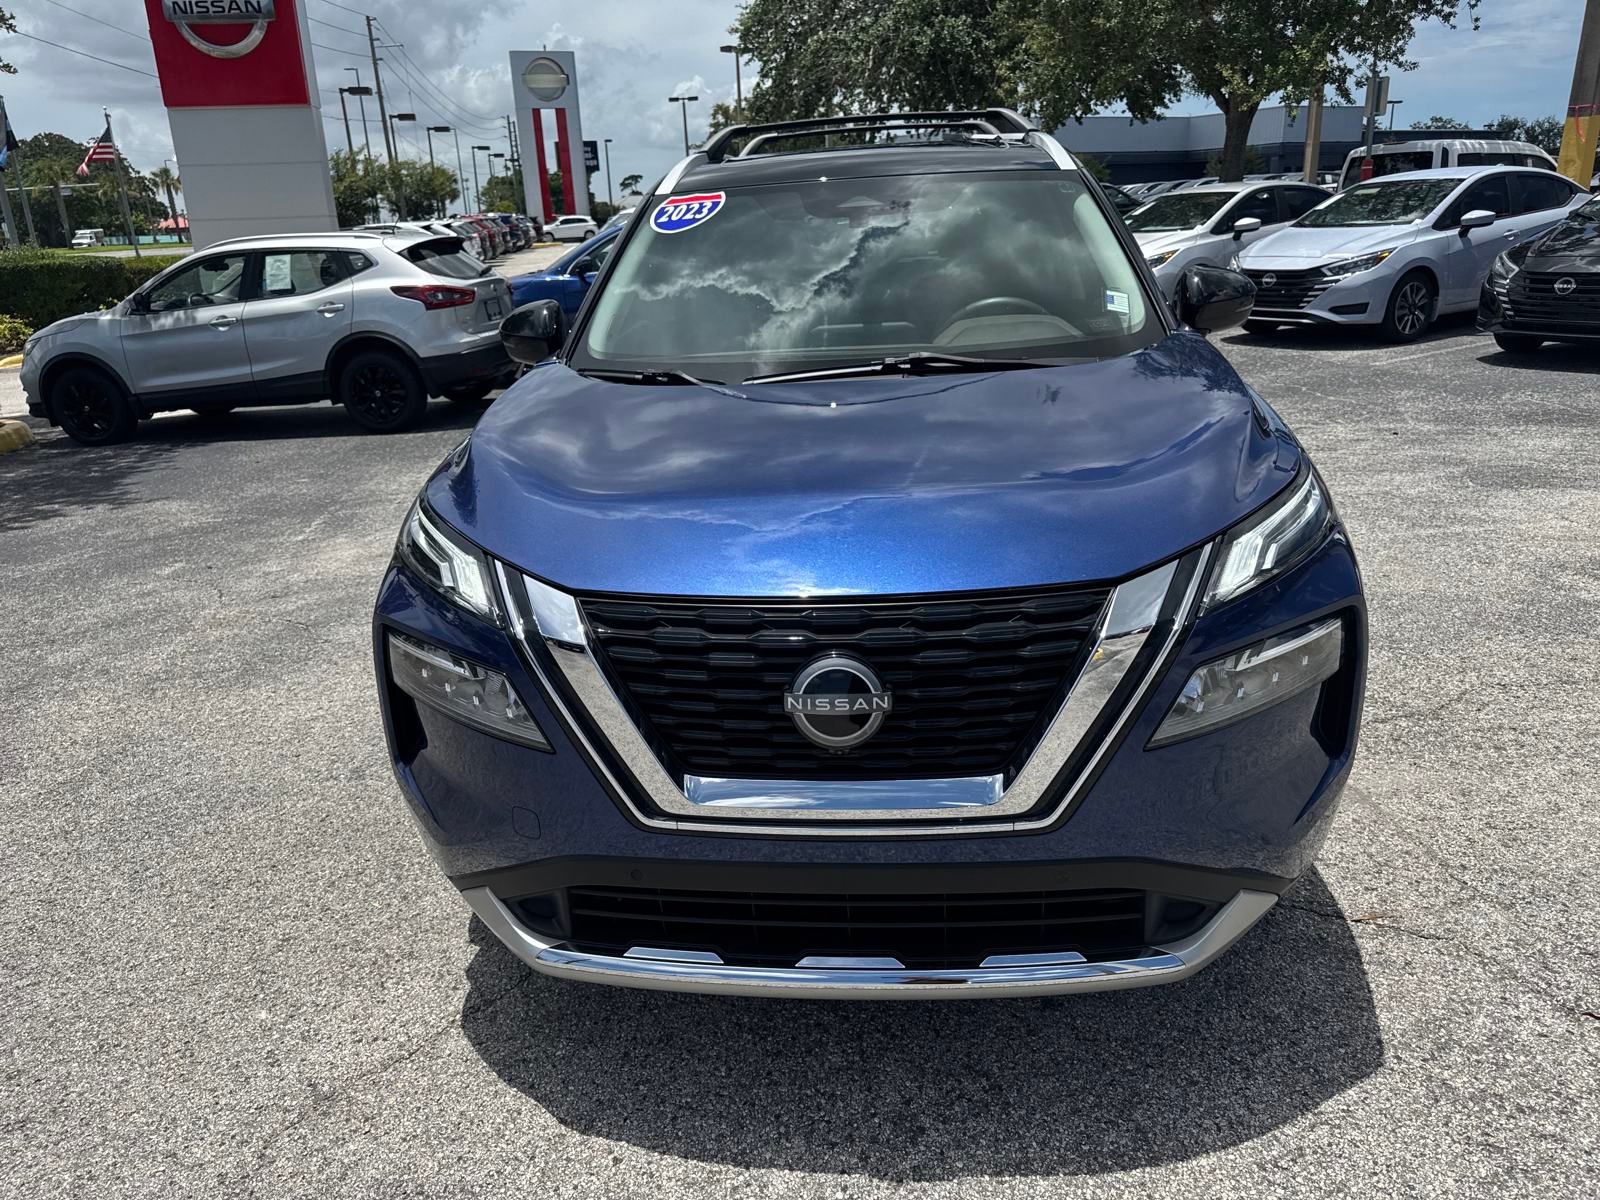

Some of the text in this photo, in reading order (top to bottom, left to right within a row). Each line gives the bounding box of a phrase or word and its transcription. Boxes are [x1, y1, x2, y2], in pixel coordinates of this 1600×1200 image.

[172, 0, 262, 15] NISSAN
[657, 202, 713, 223] 2023
[787, 696, 888, 711] NISSAN
